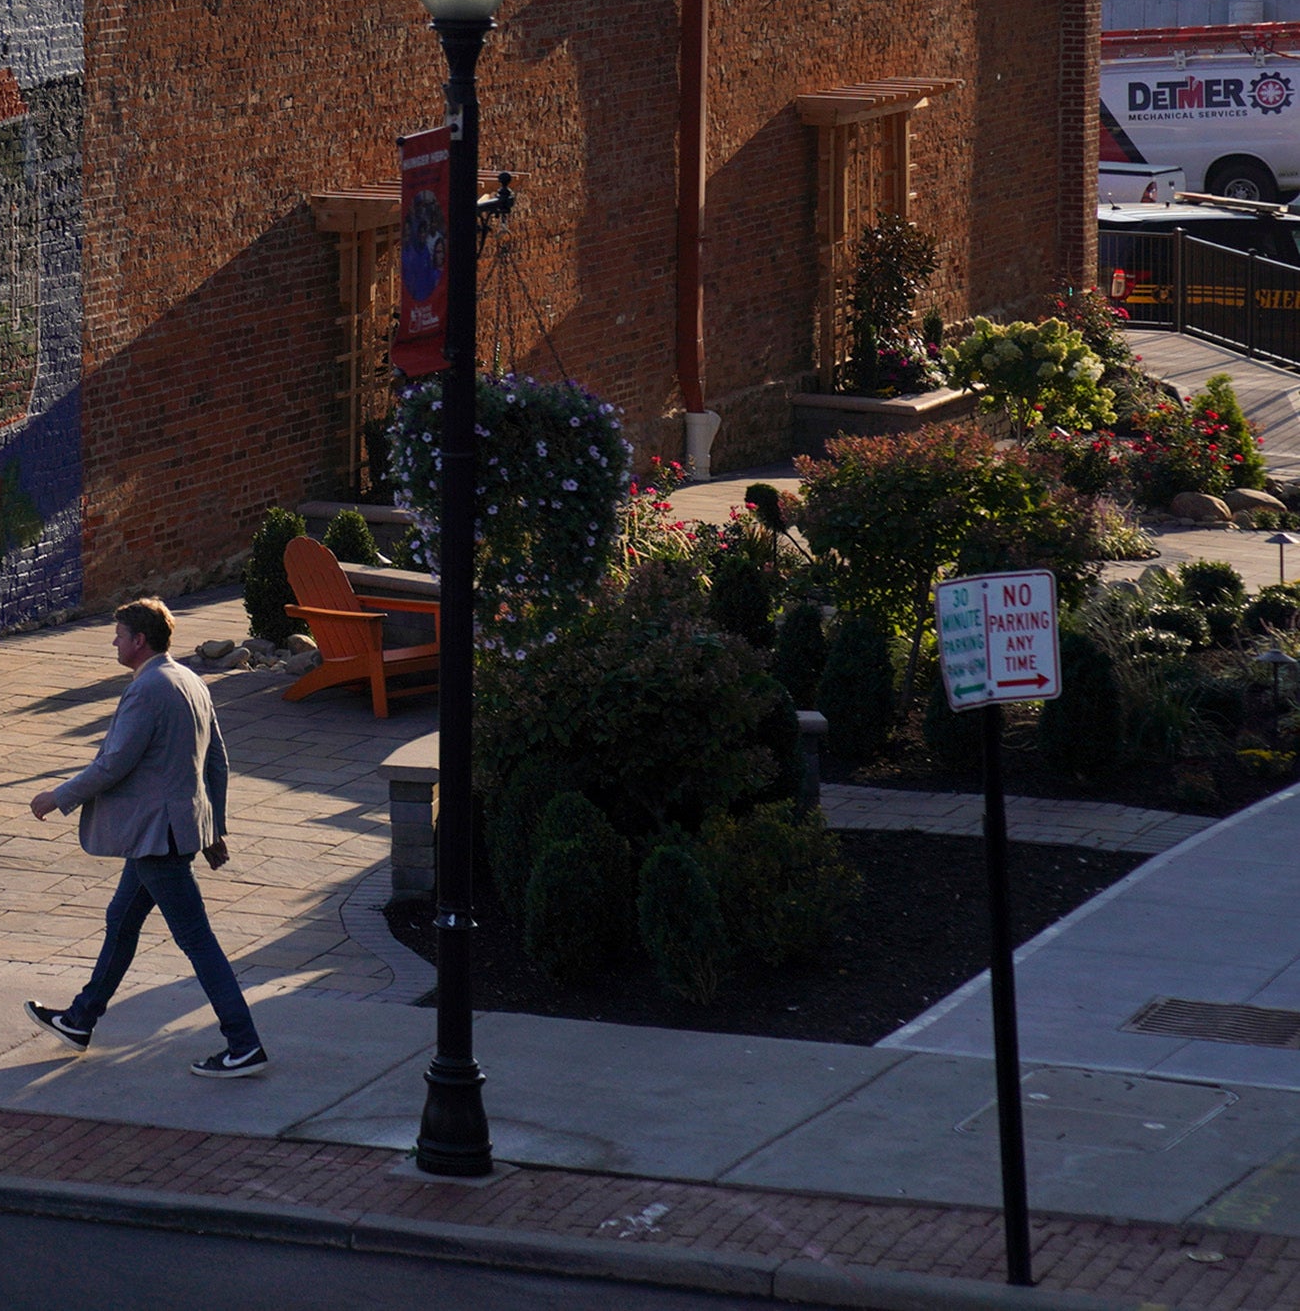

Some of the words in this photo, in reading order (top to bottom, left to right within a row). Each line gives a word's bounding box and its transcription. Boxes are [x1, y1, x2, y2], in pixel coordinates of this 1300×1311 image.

[1128, 113, 1195, 121] MECHANICAL
[1198, 109, 1248, 119] SERVICES
[952, 587, 969, 609] 30
[1003, 582, 1032, 608] NO
[942, 608, 982, 632] MINUTE
[988, 610, 1050, 633] PARKING
[944, 633, 985, 655] PARKING
[1006, 634, 1035, 652] ANY
[1004, 654, 1037, 673] TIME
